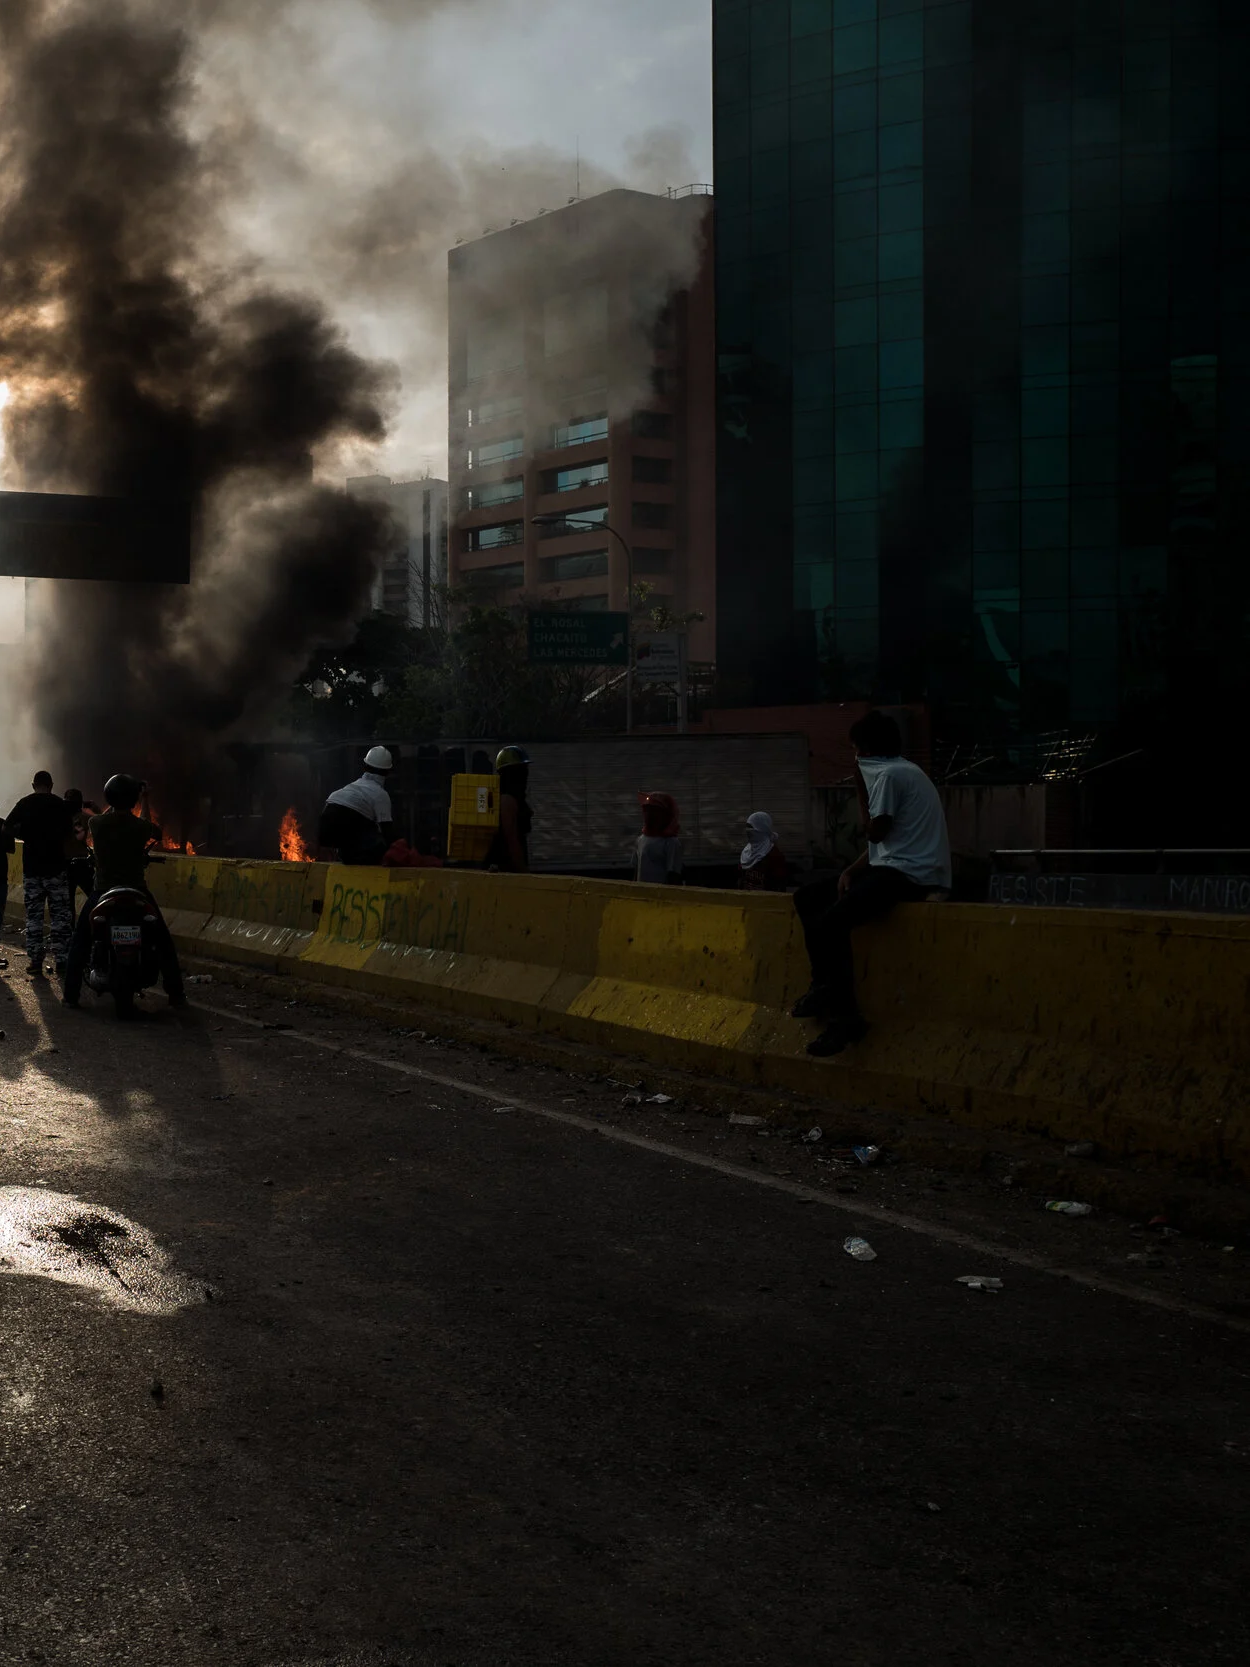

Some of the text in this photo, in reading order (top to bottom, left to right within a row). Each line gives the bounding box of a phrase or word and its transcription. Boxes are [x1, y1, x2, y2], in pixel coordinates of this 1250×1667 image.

[533, 617, 586, 629] EL ROSAL
[533, 646, 608, 659] LAS MERCEDES
[989, 874, 1087, 906] RESISTE
